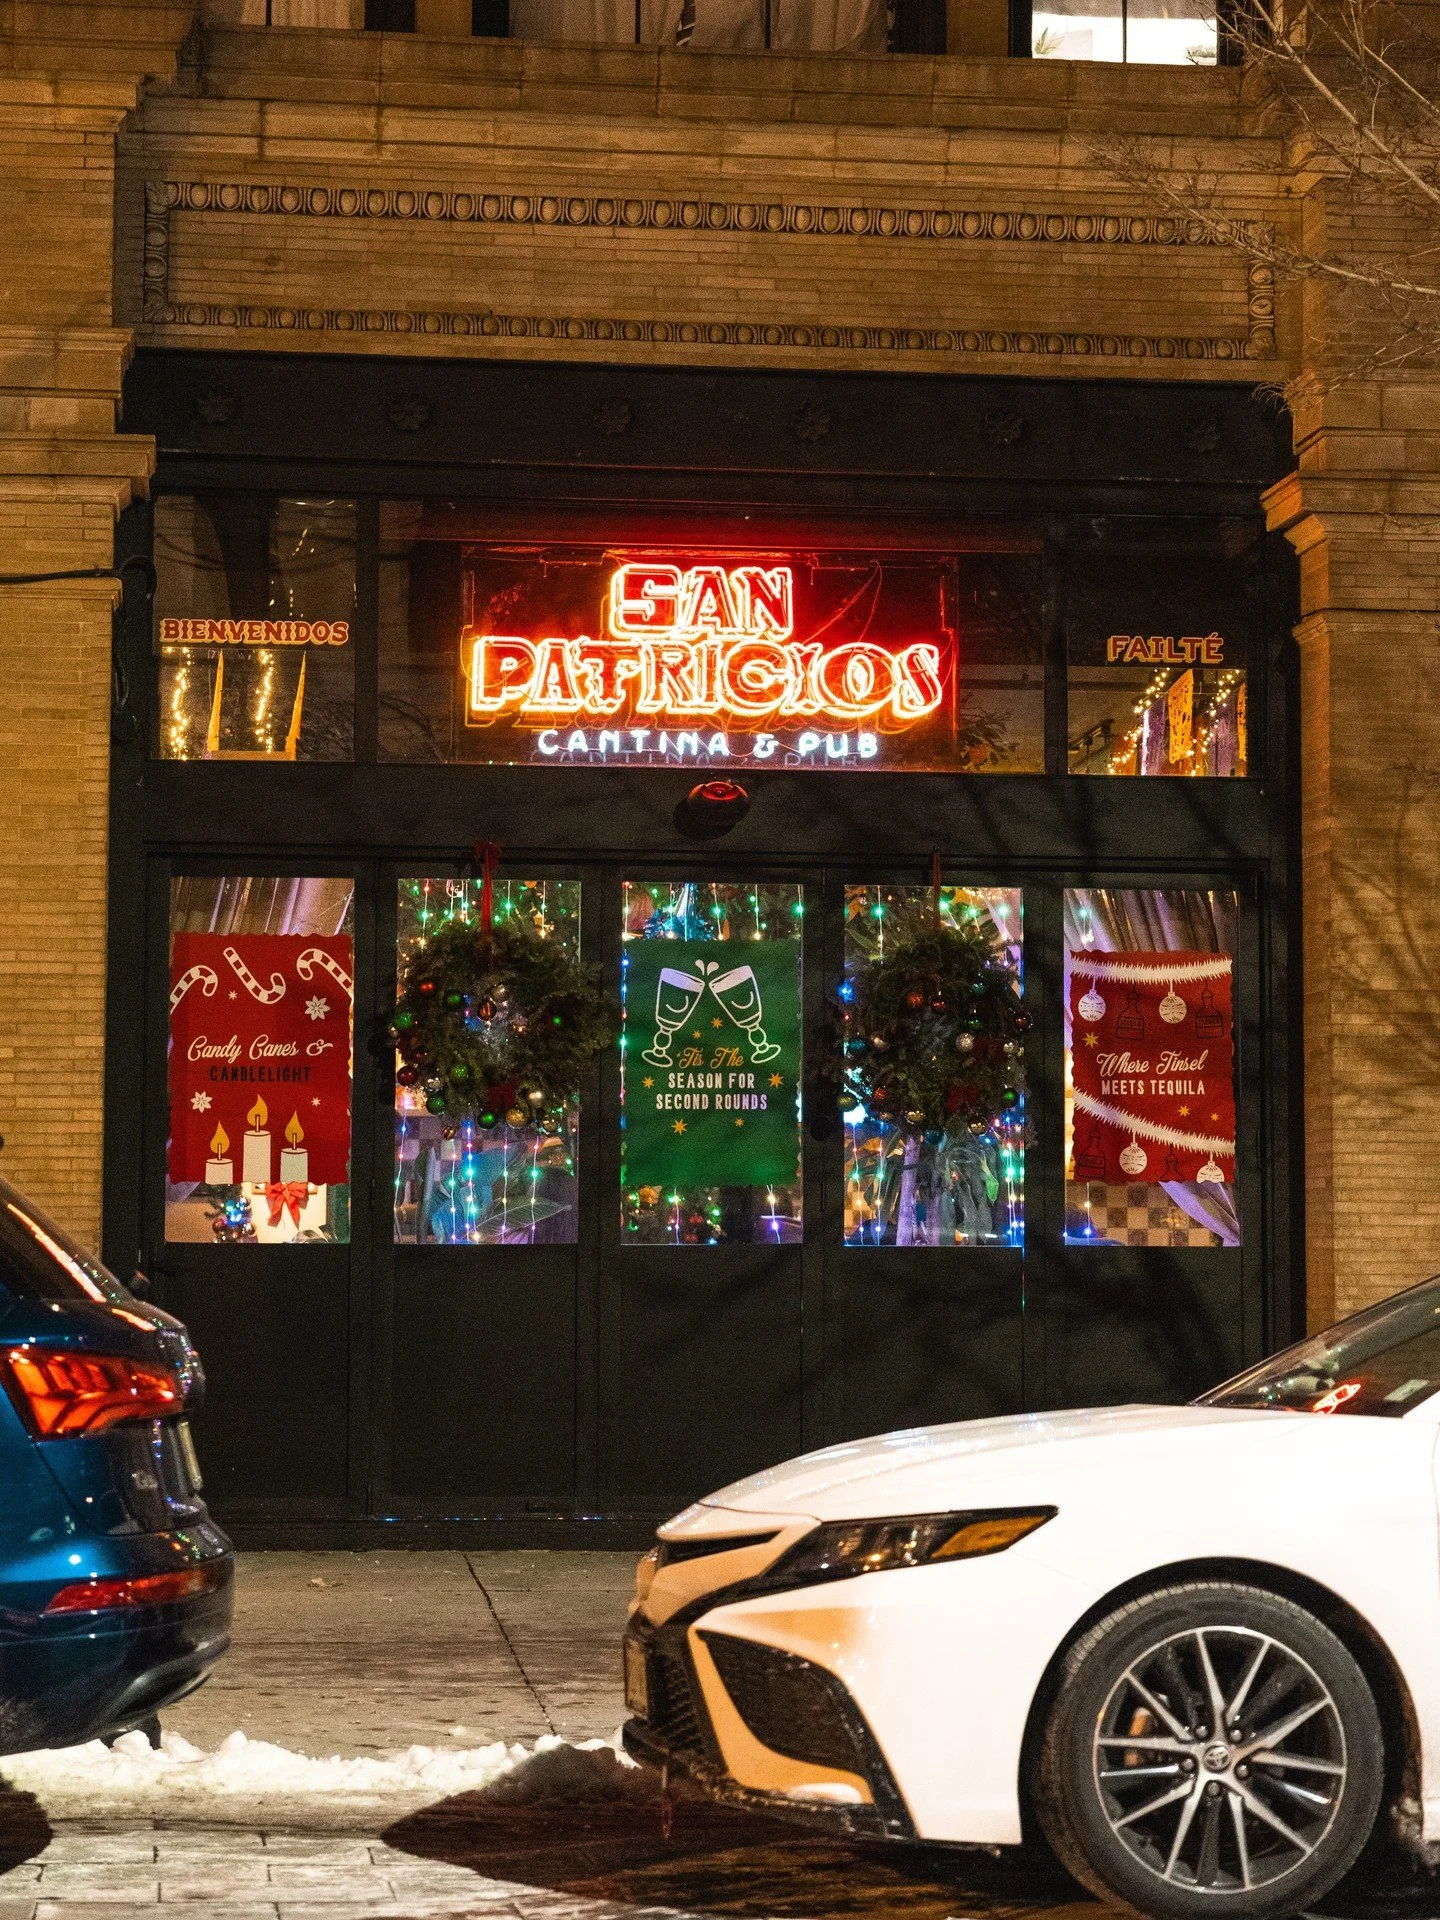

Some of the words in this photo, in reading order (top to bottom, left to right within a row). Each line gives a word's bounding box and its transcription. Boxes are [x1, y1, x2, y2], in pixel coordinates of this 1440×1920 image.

[610, 564, 793, 641] SAN
[160, 618, 349, 645] BIENVENIDOS
[1107, 632, 1224, 664] FAILTÉ
[470, 635, 943, 719] PATRICIOS
[538, 728, 731, 757] CANTINA
[753, 733, 780, 757] &
[799, 731, 880, 759] PUB
[187, 1034, 242, 1064] Candy
[249, 1034, 299, 1060] Canes
[305, 1038, 334, 1057] &
[710, 1046, 744, 1069] The
[209, 1065, 311, 1083] CANDLELIGHT
[1096, 1051, 1150, 1077] Where
[1156, 1049, 1209, 1075] Tinsel
[668, 1072, 722, 1089] SEASON
[728, 1072, 755, 1089] FOR
[1101, 1079, 1144, 1095] MEETS
[1150, 1079, 1206, 1096] TEQUILA
[656, 1093, 709, 1110] SECOND
[715, 1093, 768, 1110] ROUNDS
